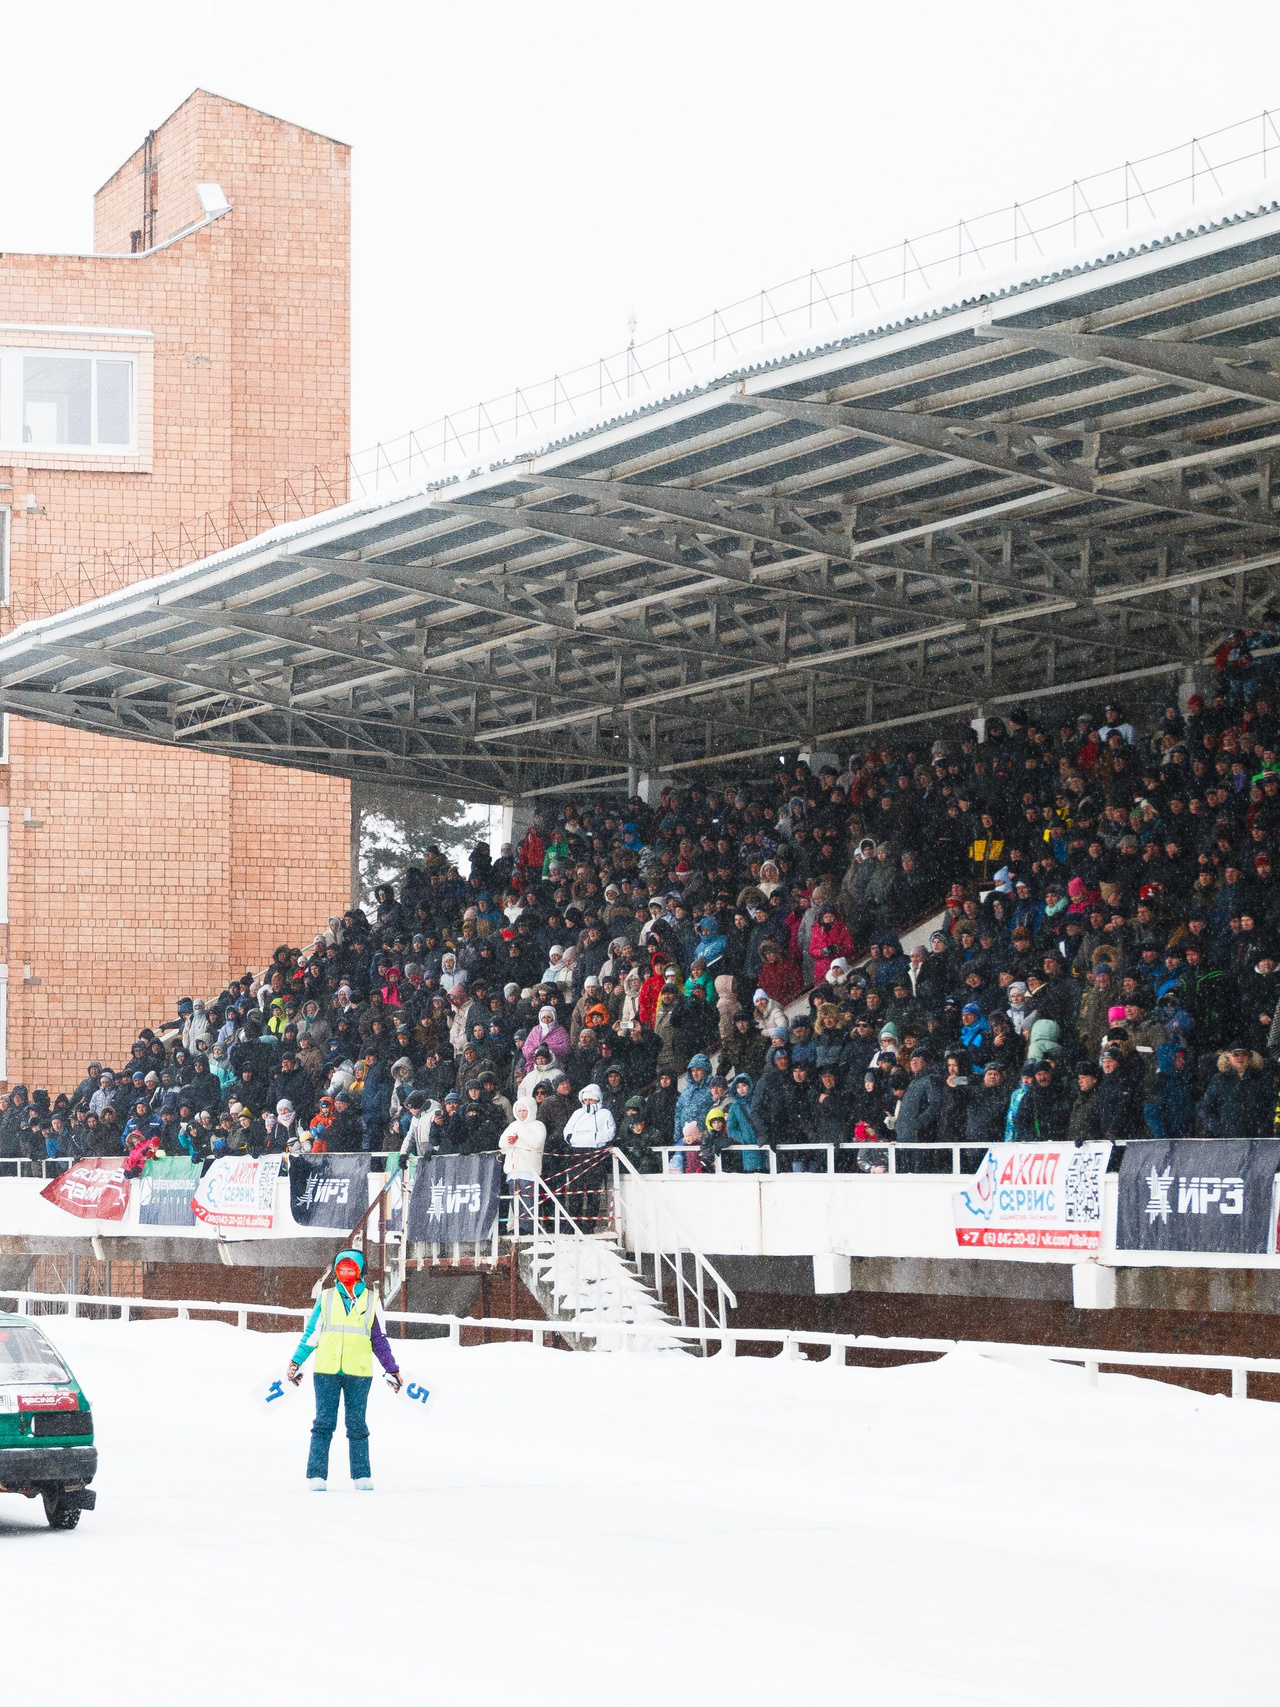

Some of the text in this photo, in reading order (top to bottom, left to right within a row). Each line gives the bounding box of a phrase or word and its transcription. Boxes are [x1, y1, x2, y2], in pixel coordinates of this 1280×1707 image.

[314, 1178, 350, 1204] ИРЗ
[999, 1189, 1056, 1211] СЕРВИС
[1178, 1177, 1244, 1215] ИРЗ
[962, 1232, 980, 1243] +7
[265, 1379, 285, 1403] 4
[406, 1382, 431, 1404] 5
